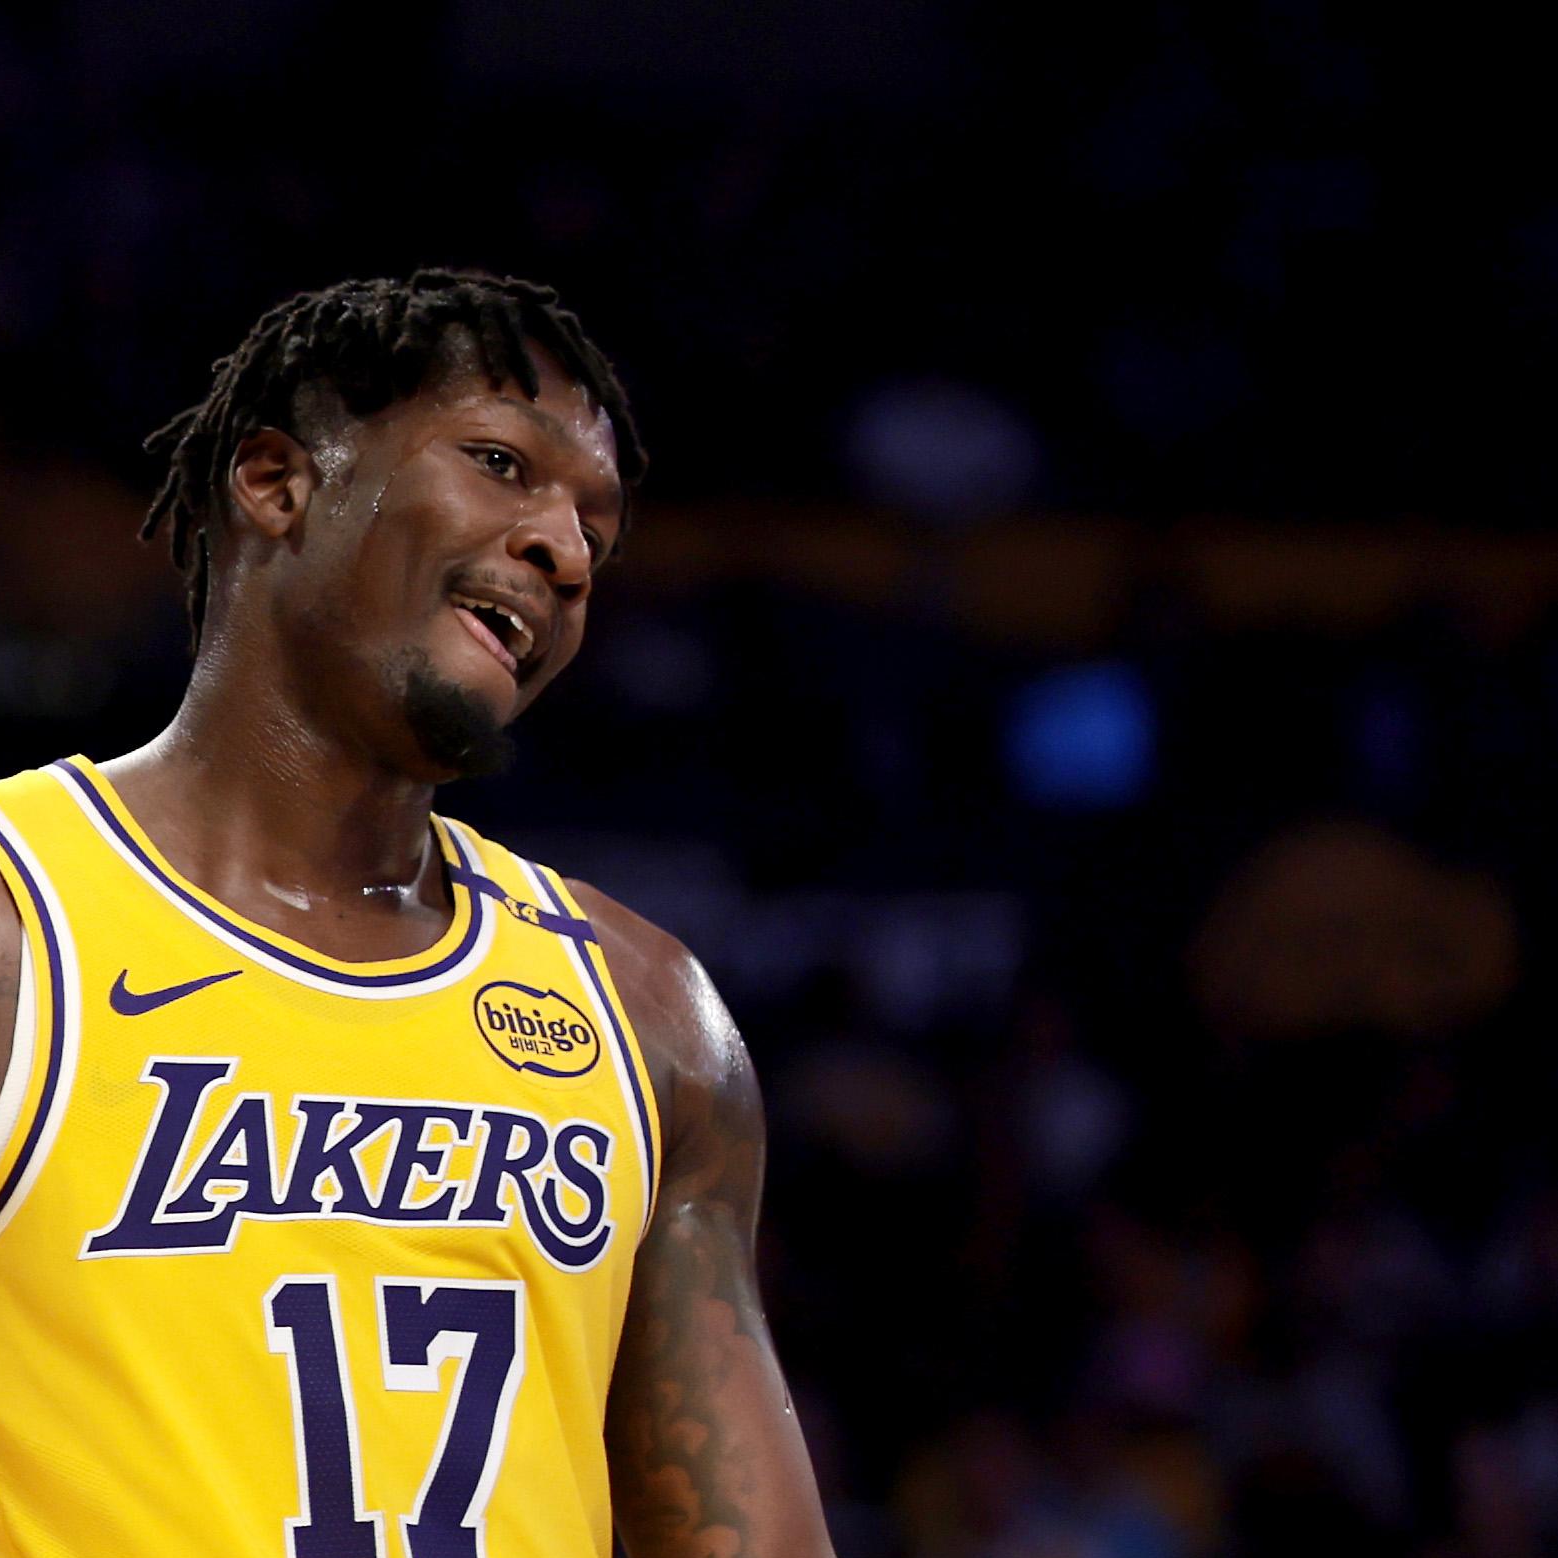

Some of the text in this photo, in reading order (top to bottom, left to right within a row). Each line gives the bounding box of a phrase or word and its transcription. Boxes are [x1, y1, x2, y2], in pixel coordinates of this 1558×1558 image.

[483, 1001, 591, 1052] bibigo
[509, 1035, 555, 1056] 비비고
[77, 1056, 615, 1273] LAKERS
